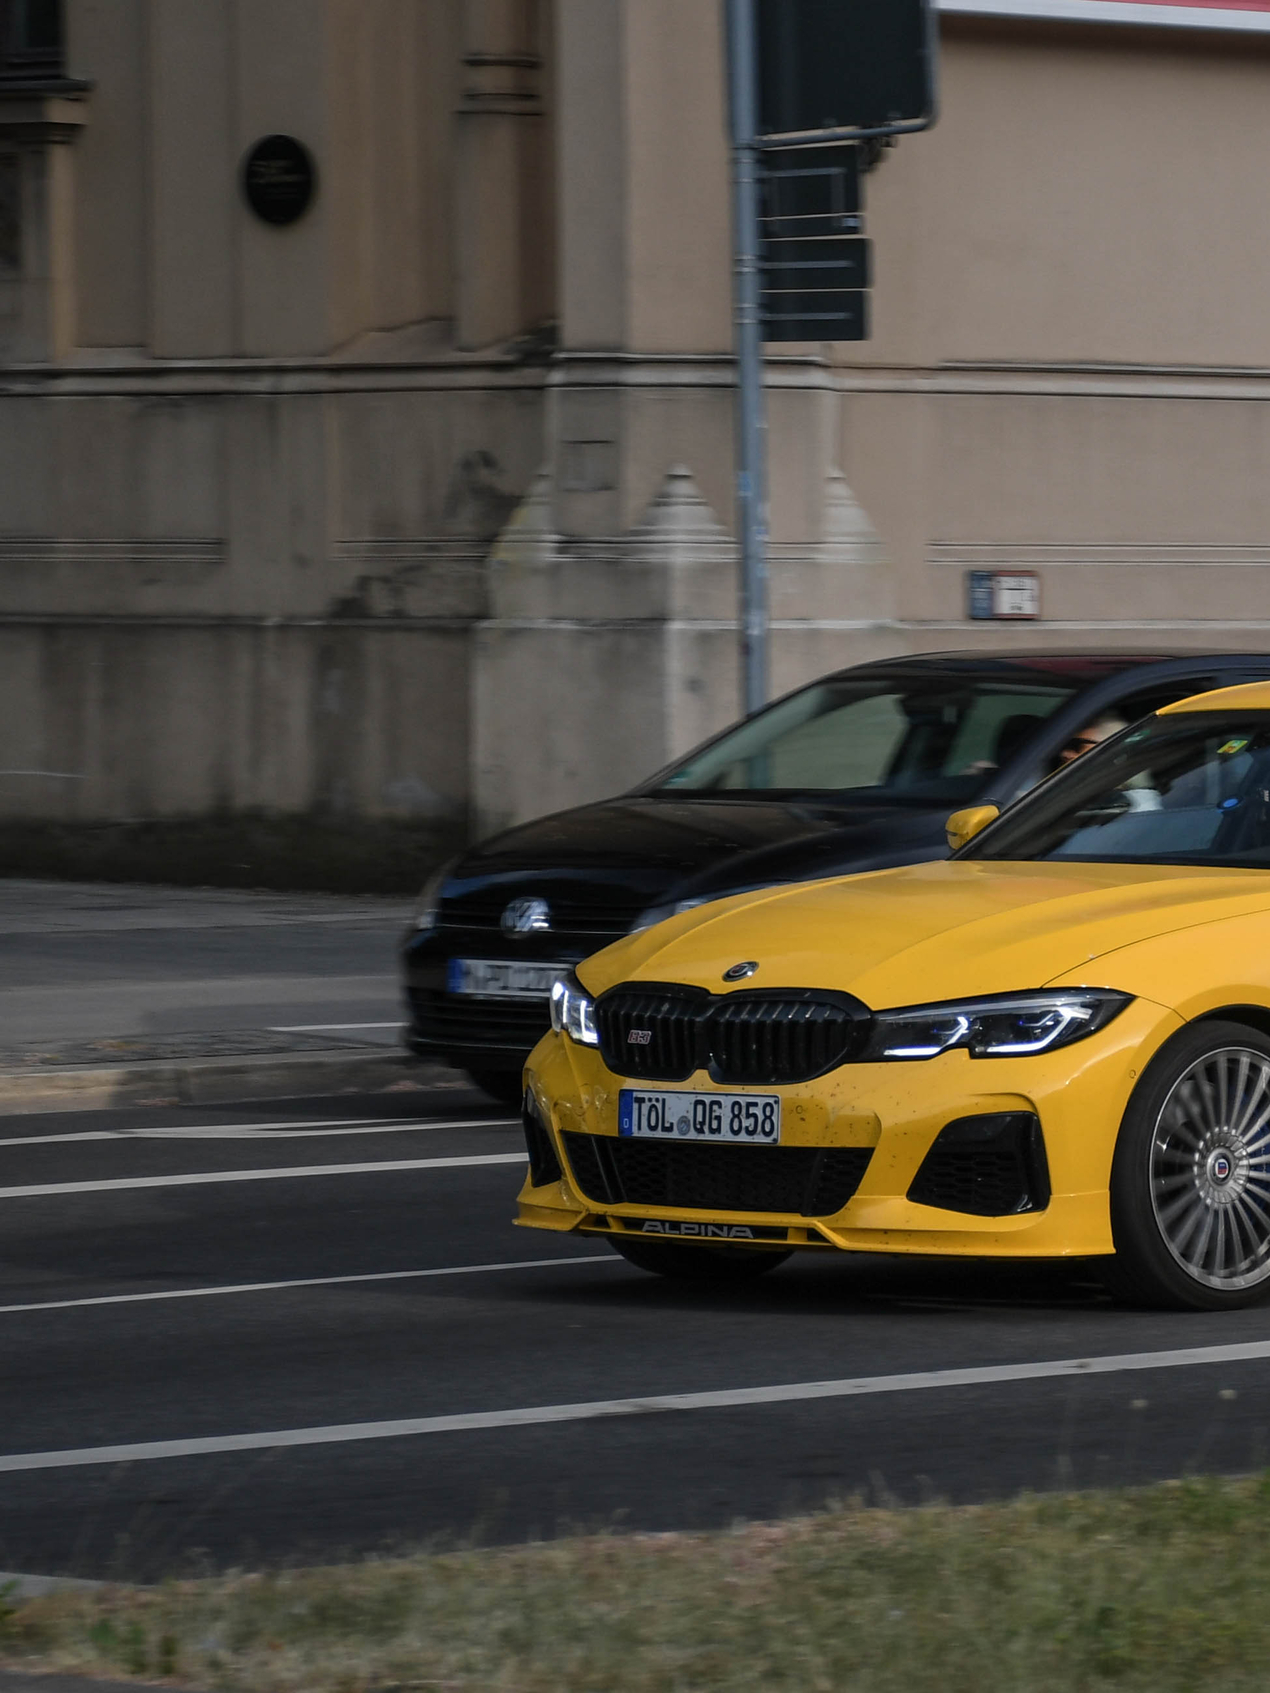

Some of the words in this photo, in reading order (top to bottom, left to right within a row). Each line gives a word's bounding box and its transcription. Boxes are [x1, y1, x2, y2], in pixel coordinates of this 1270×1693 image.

[634, 1096, 674, 1133] TÖL
[693, 1099, 722, 1135] QG
[729, 1100, 775, 1137] 858
[641, 1220, 754, 1239] ALPINA
